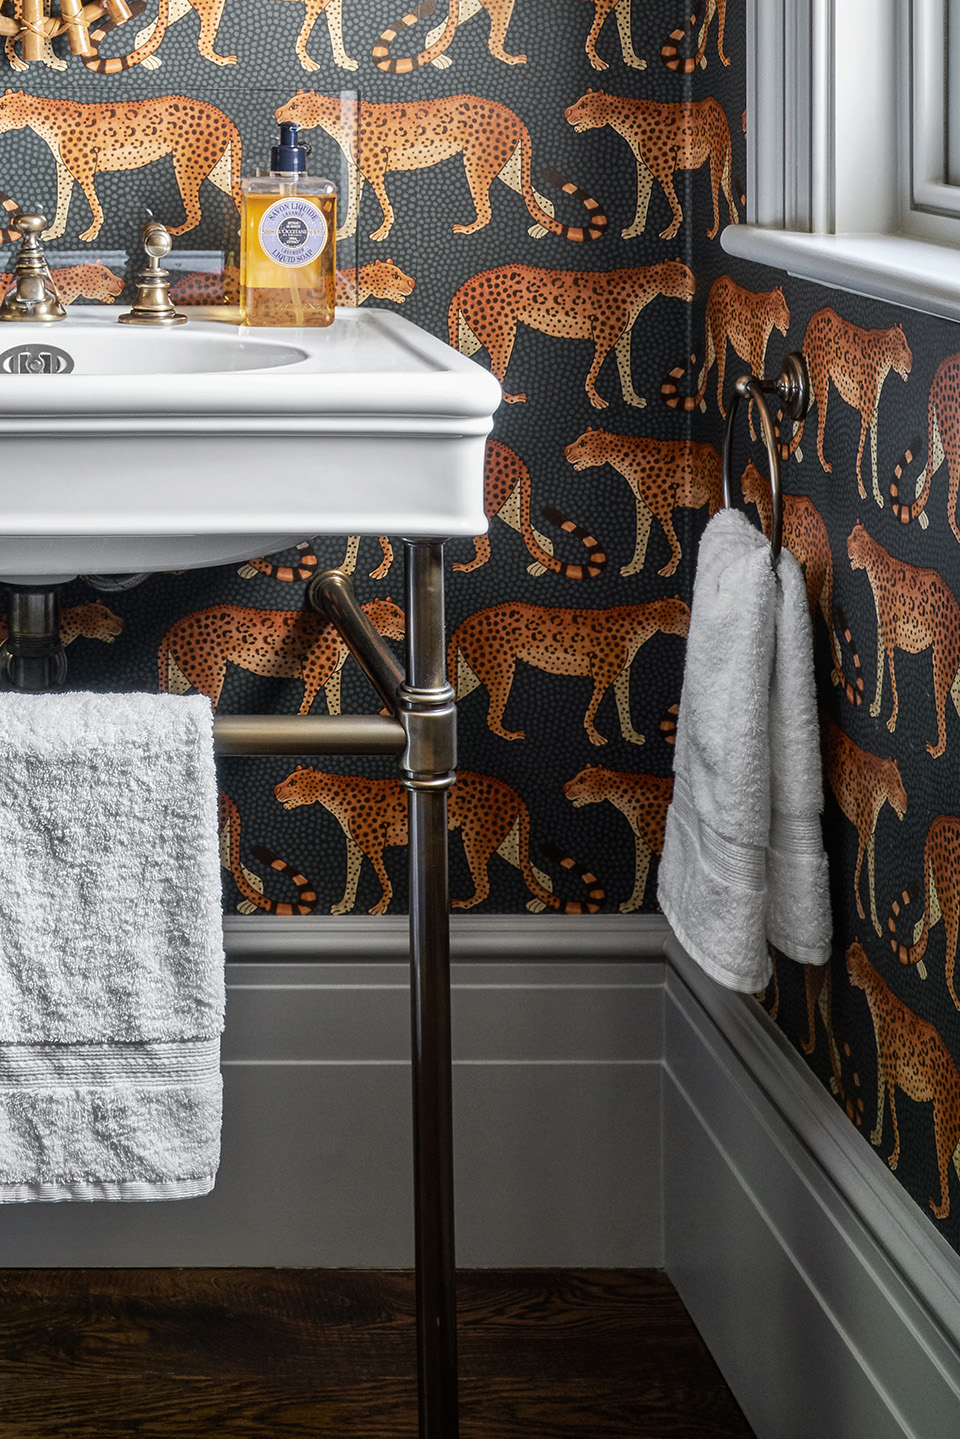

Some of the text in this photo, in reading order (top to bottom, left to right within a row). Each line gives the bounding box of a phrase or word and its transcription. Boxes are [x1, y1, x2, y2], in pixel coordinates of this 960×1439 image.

[269, 203, 318, 221] SAVON LIQUIDE
[272, 249, 312, 263] LIQUID SOAP
